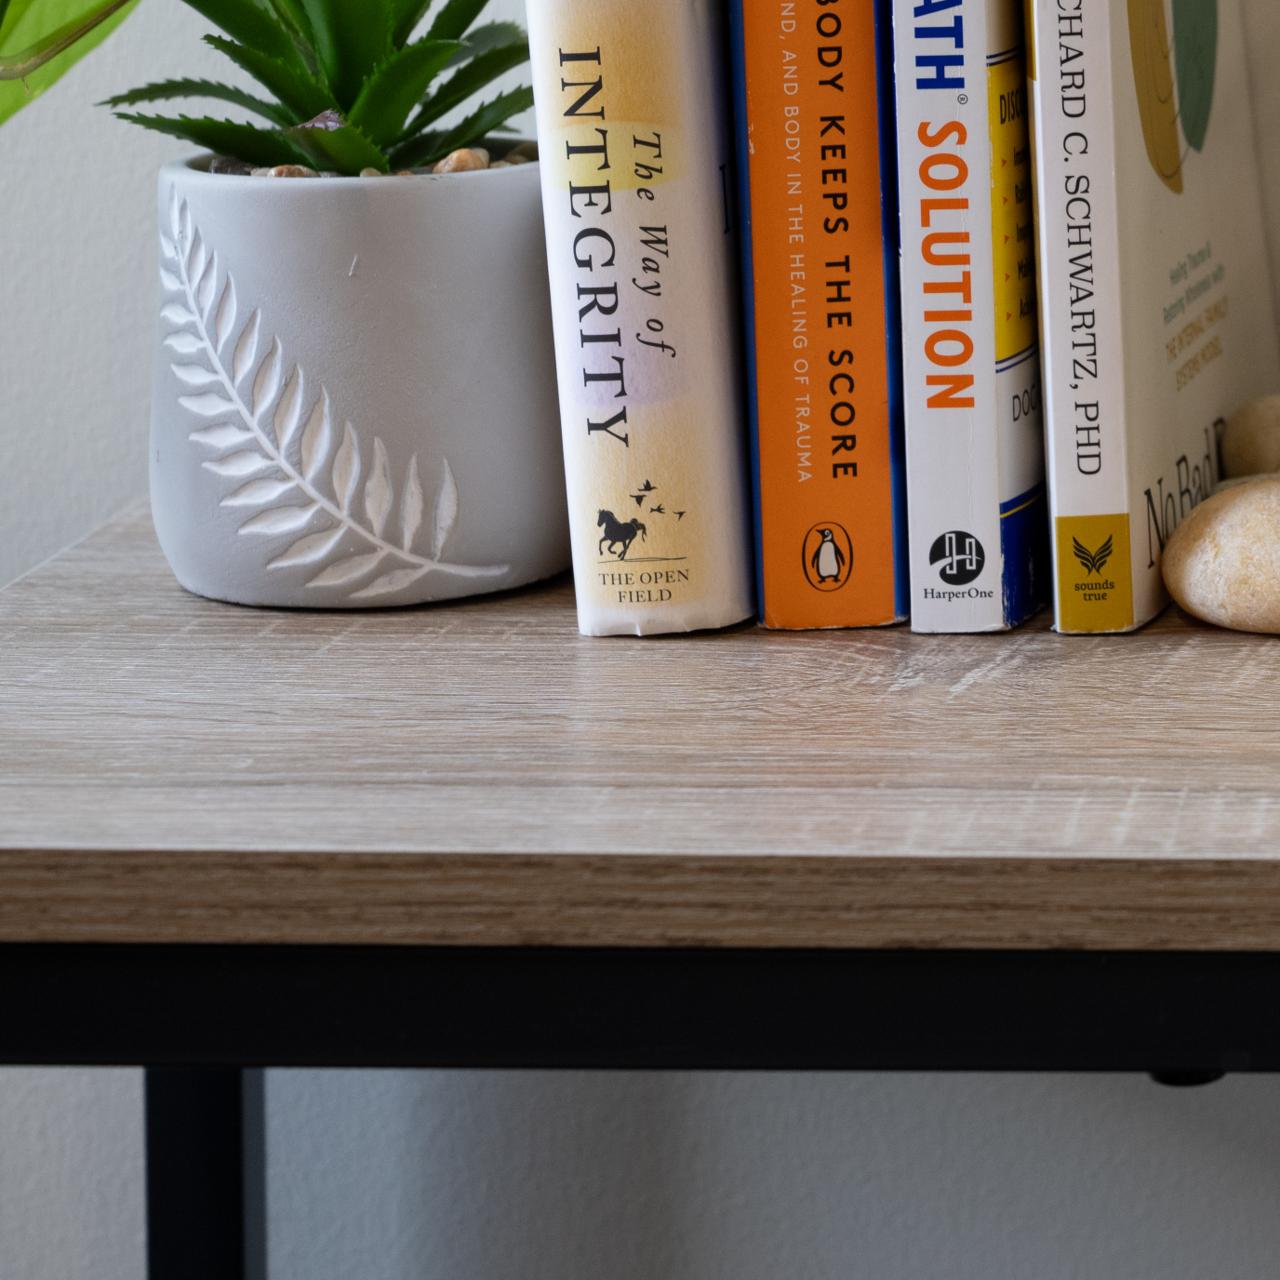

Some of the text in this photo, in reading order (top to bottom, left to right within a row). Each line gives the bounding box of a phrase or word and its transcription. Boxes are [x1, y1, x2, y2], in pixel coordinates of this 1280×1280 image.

[782, 50, 798, 97] AND
[784, 105, 800, 161] BODY
[1062, 132, 1088, 163] C.
[786, 172, 802, 195] IN
[820, 116, 850, 234] KEEPS
[559, 46, 629, 447] INTEGRITY
[632, 132, 677, 358] The Way of
[788, 204, 804, 244] THE
[824, 256, 853, 329] THE
[916, 120, 976, 410] SOLUTION
[1064, 175, 1098, 390] SCHWARTZ,
[789, 253, 808, 349] HEALING
[793, 358, 809, 385] OF
[794, 393, 812, 483] TRAUMA
[829, 349, 858, 479] SCORE
[1074, 402, 1101, 476] PHD
[599, 569, 689, 585] THE OPEN
[618, 589, 672, 602] FIELD
[924, 587, 994, 601] HarperOne
[1074, 579, 1115, 591] sounds
[1083, 592, 1108, 601] true
